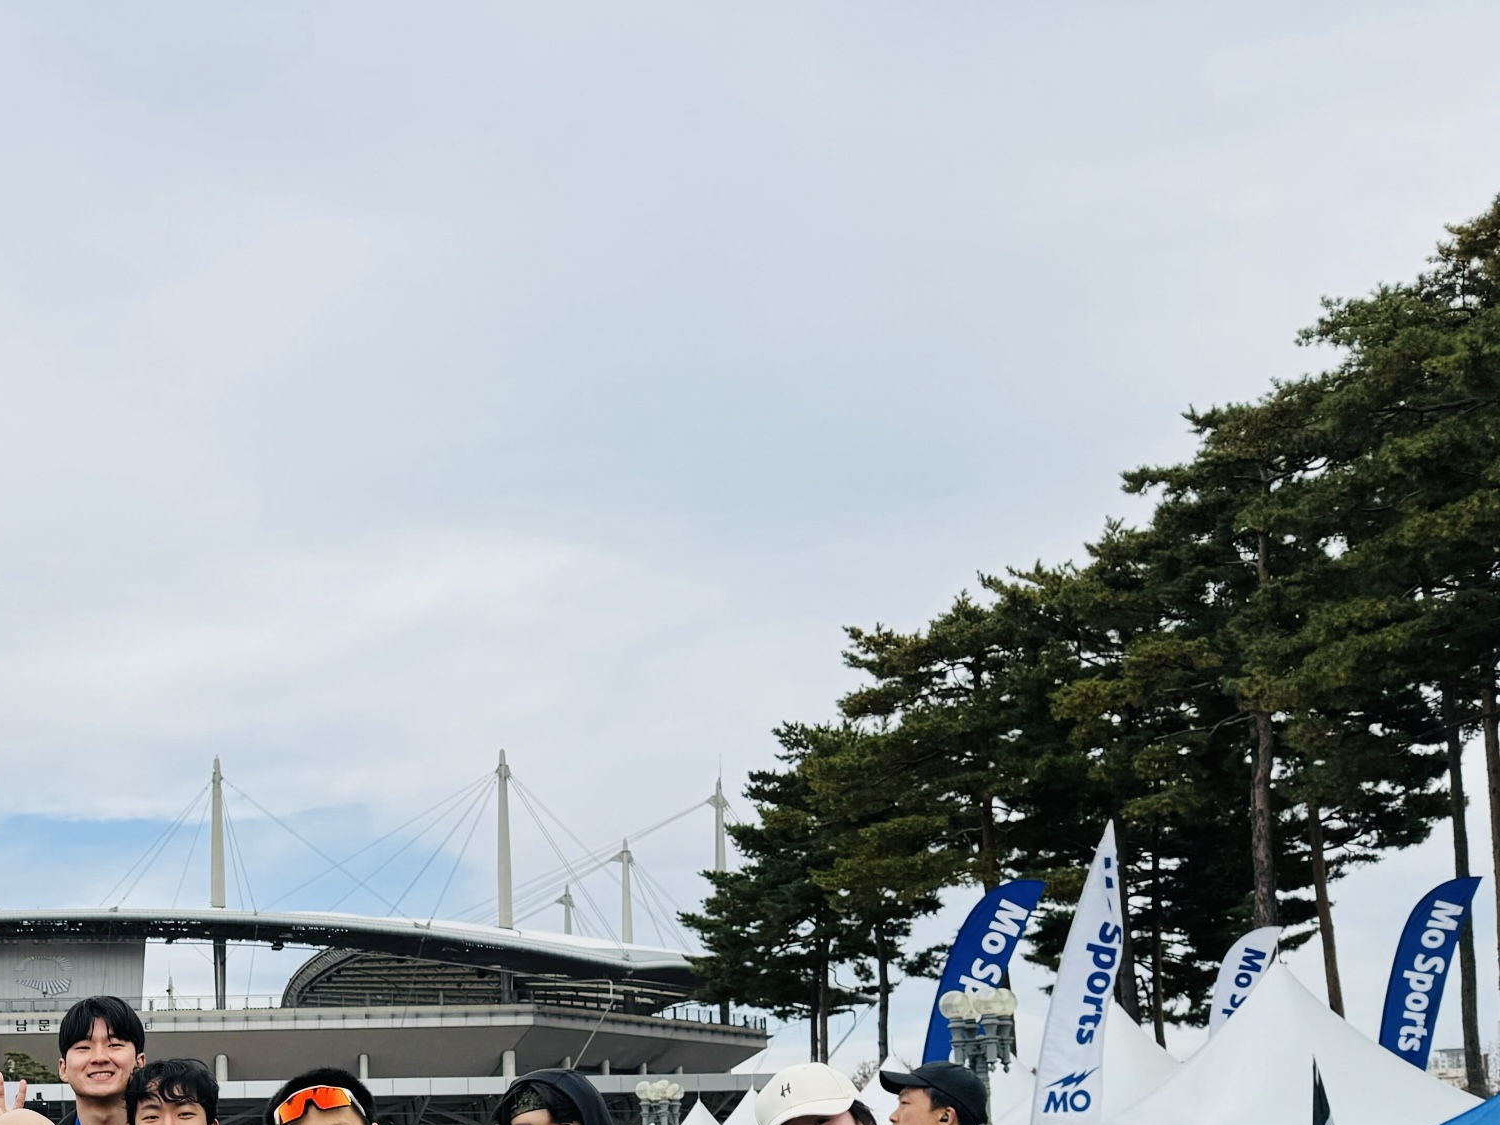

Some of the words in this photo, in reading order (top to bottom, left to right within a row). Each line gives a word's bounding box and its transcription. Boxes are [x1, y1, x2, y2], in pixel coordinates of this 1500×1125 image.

[981, 899, 1029, 955] Mo
[1421, 900, 1464, 949] Mo
[1076, 921, 1122, 1045] Sports
[1234, 947, 1267, 988] Mo
[1397, 953, 1445, 1052] Sports
[1043, 1089, 1091, 1113] MO
